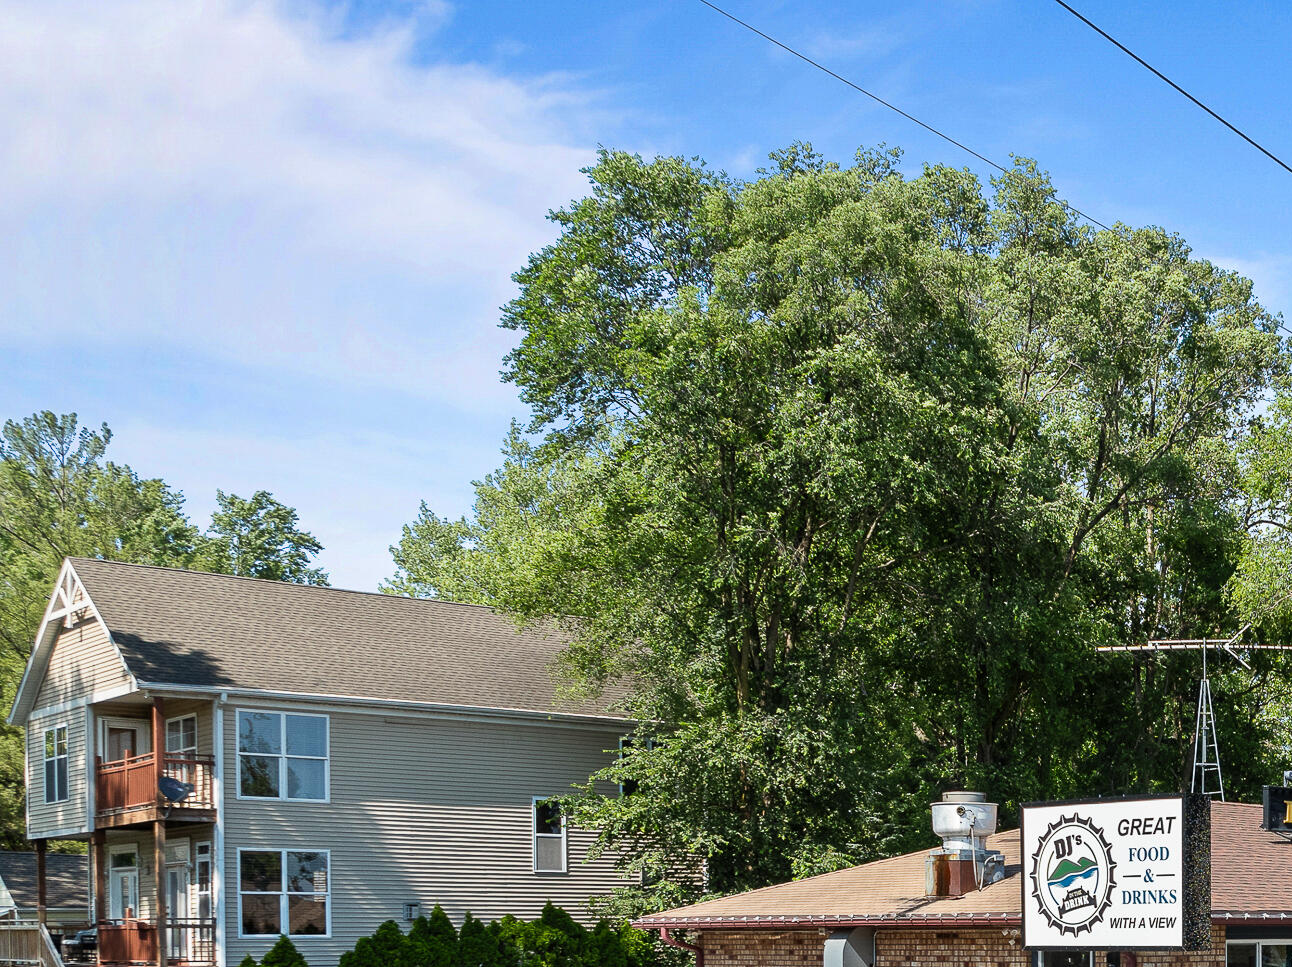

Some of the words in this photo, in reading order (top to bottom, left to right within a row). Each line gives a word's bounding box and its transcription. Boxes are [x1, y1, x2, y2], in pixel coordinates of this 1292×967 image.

[1118, 816, 1177, 837] GREAT
[1054, 834, 1083, 859] DJ's
[1128, 846, 1170, 862] FOOD
[1143, 868, 1155, 883] &
[1064, 895, 1090, 911] DRINK
[1122, 889, 1177, 905] DRINKS
[1110, 918, 1137, 929] WITH
[1138, 918, 1146, 929] A
[1148, 917, 1177, 929] VIEW
